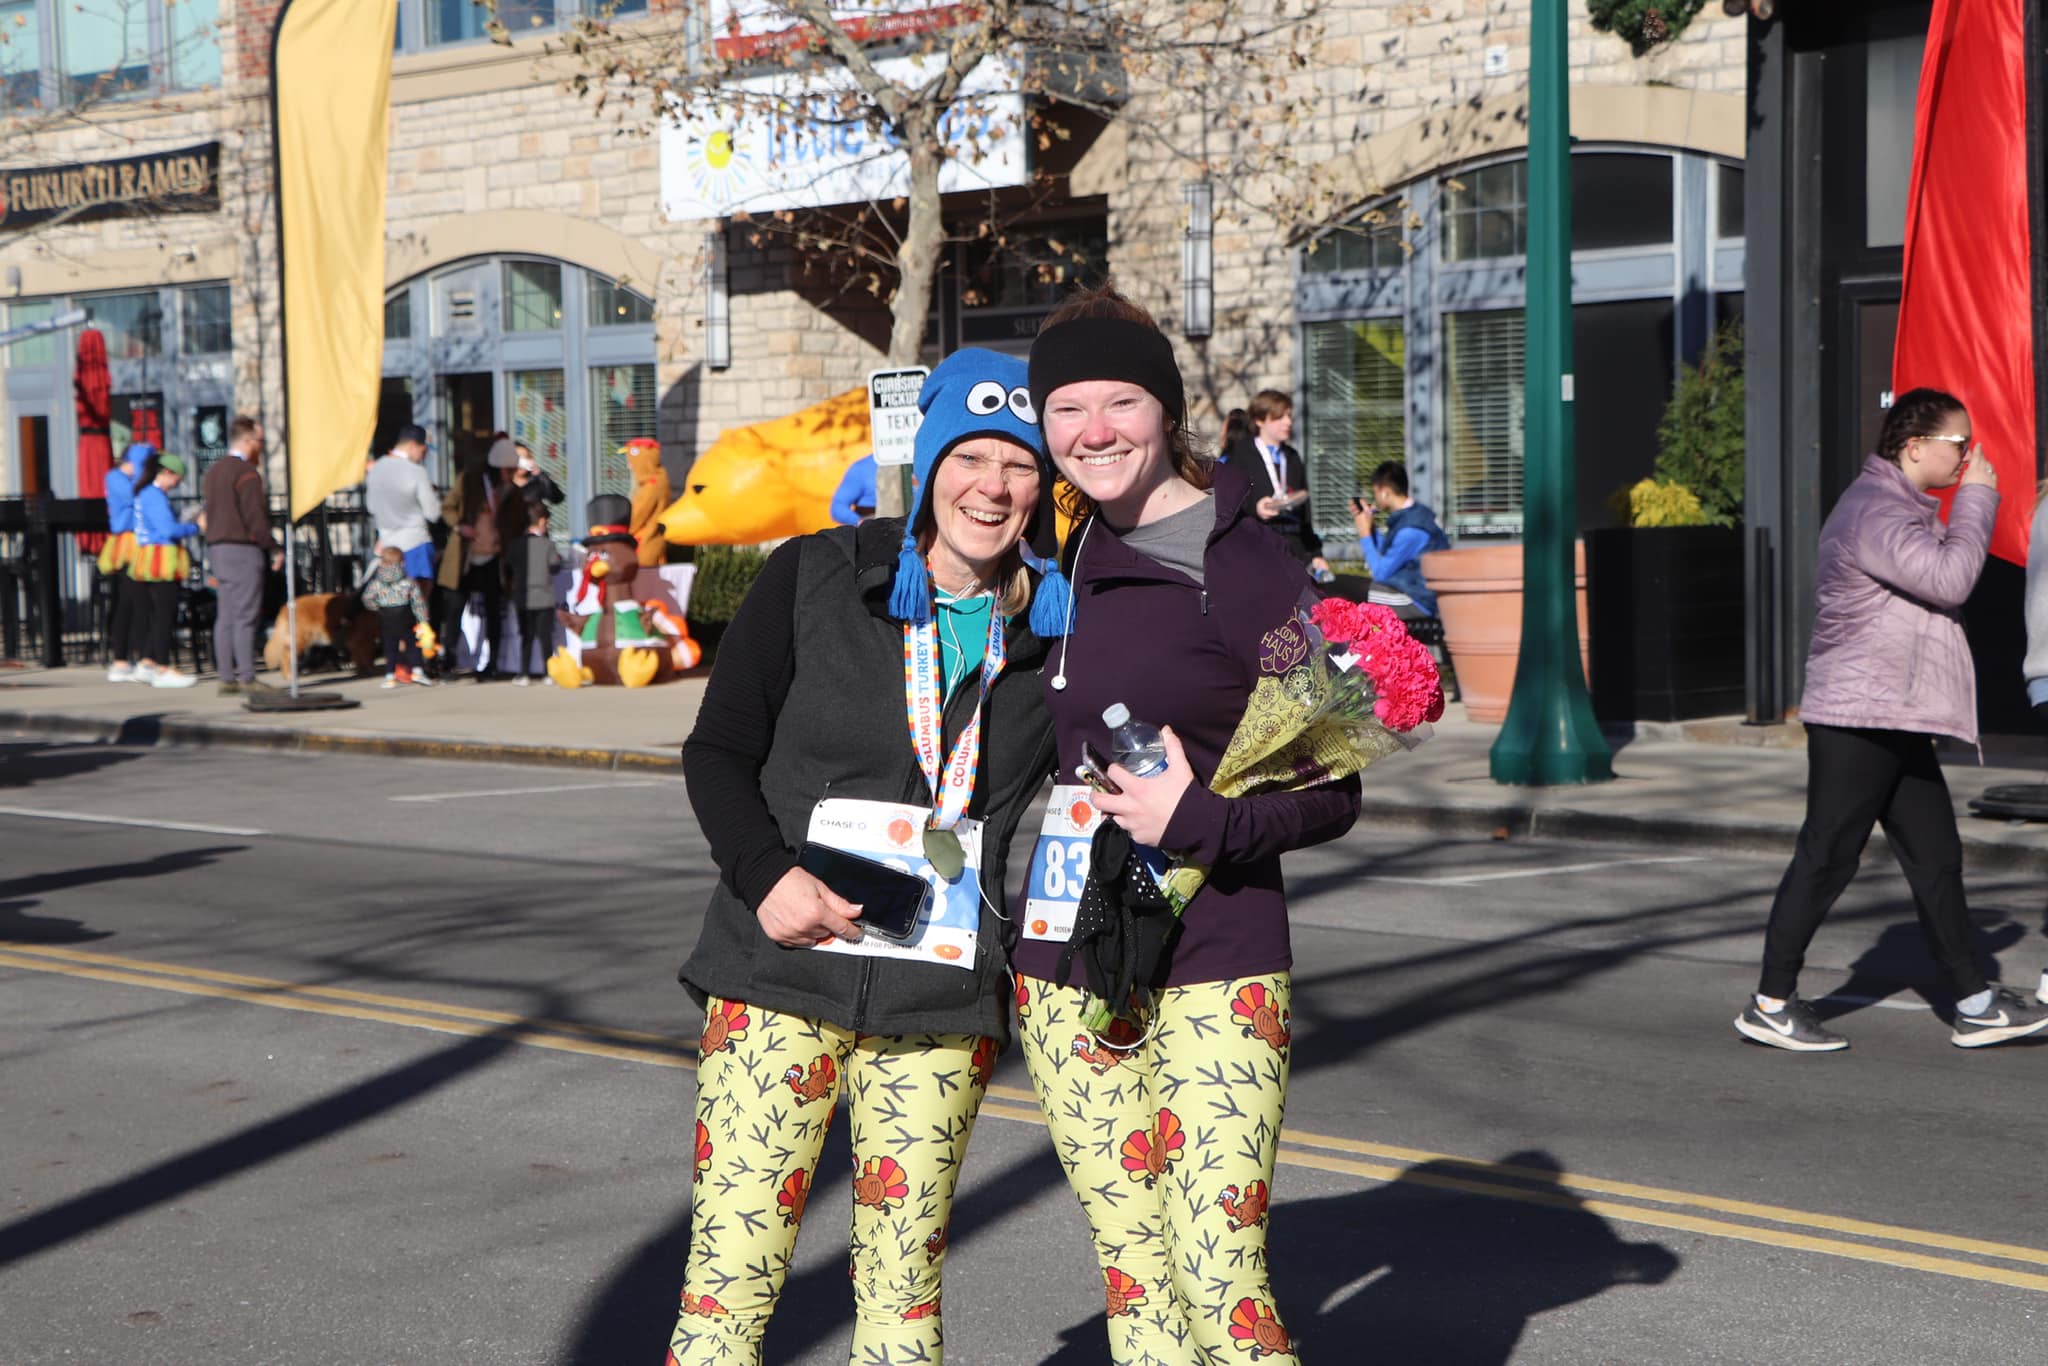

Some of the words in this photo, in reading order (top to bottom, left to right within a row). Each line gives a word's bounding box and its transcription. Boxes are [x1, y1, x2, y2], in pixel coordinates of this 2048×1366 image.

[119, 155, 208, 200] RAMEN
[887, 412, 918, 429] TEXT
[1261, 631, 1292, 661] HAUS
[917, 640, 929, 692] TURKEY
